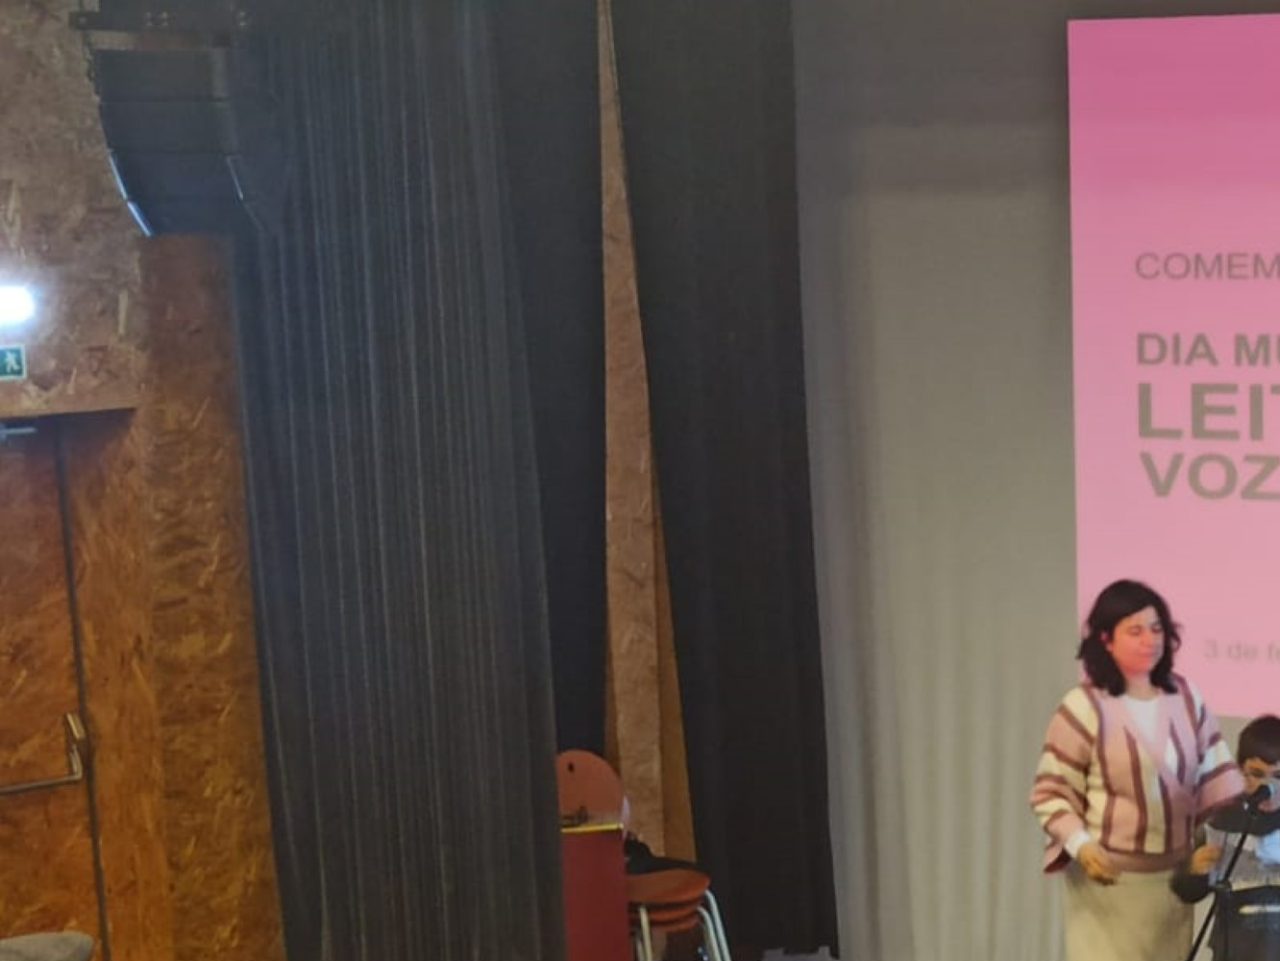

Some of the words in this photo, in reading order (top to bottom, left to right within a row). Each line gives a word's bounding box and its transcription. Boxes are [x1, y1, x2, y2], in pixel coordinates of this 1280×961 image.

[1136, 332, 1219, 366] DIA
[1203, 640, 1219, 662] 3
[1228, 640, 1259, 662] de
